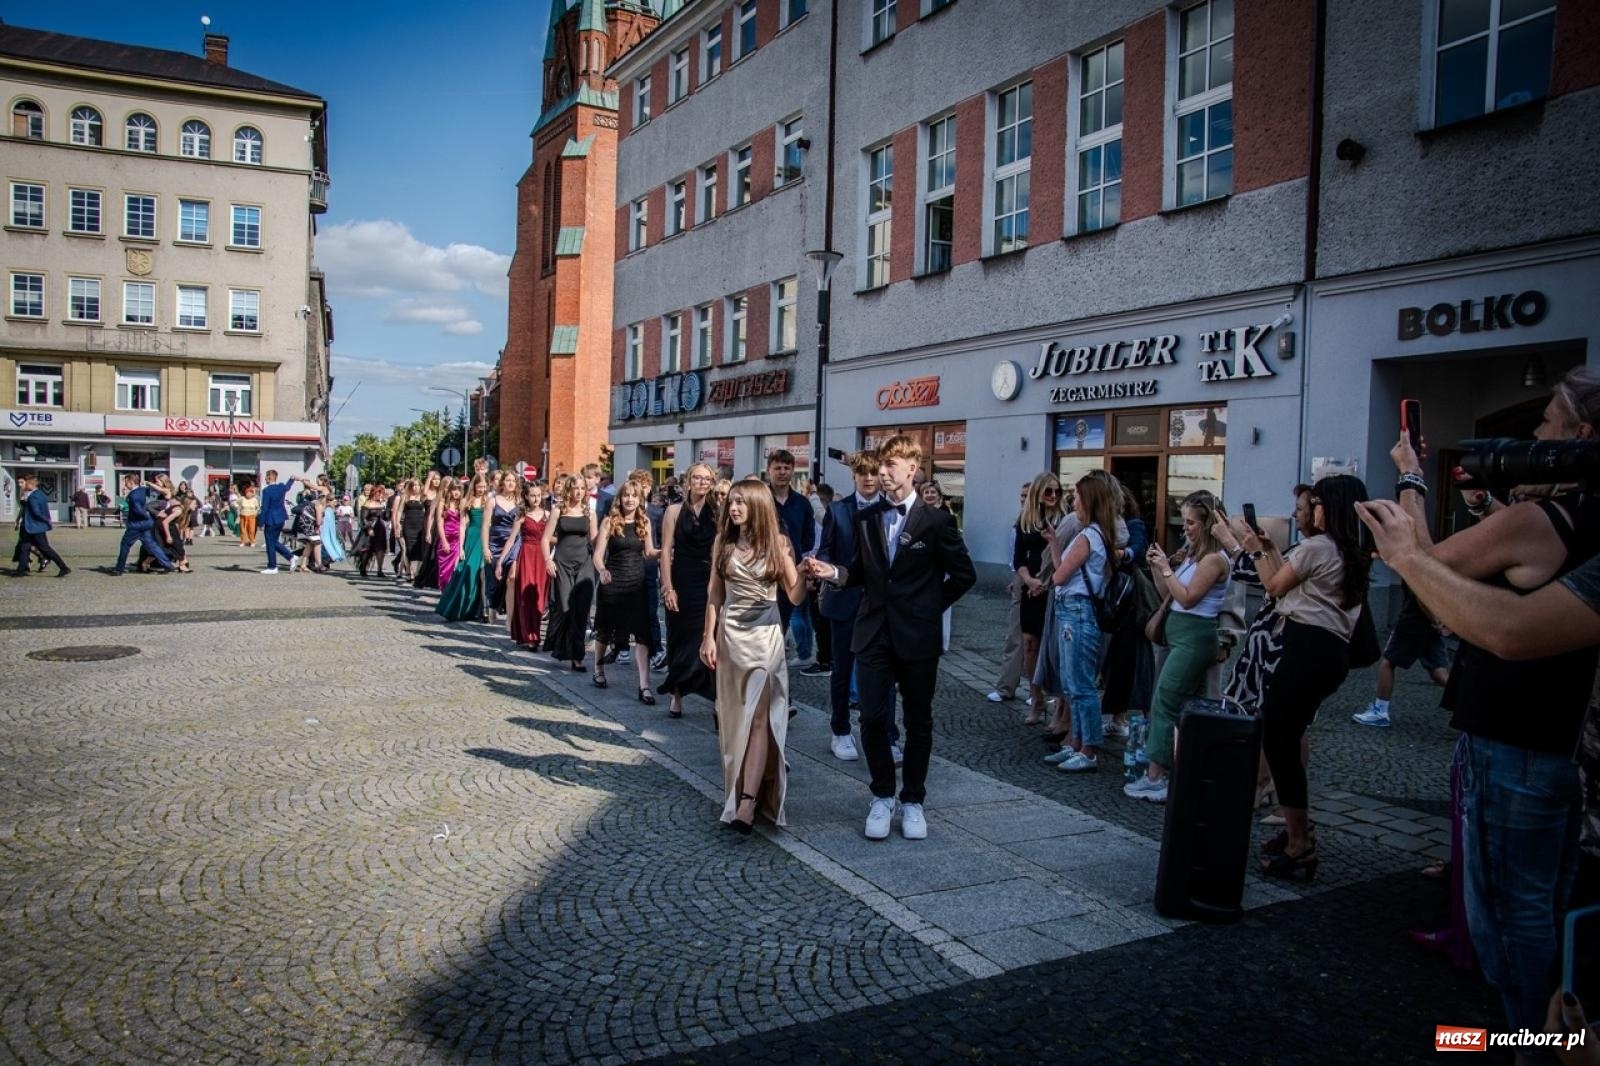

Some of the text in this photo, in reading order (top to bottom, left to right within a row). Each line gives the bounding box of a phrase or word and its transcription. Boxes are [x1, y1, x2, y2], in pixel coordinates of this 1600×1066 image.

[1398, 290, 1546, 341] BOLKO
[1028, 334, 1179, 379] JUBILER
[612, 368, 788, 419] BOLKO zaprasza
[1049, 379, 1157, 403] ZEGARMISTRZ
[28, 413, 53, 422] TEB
[164, 417, 265, 433] ROSSMANN
